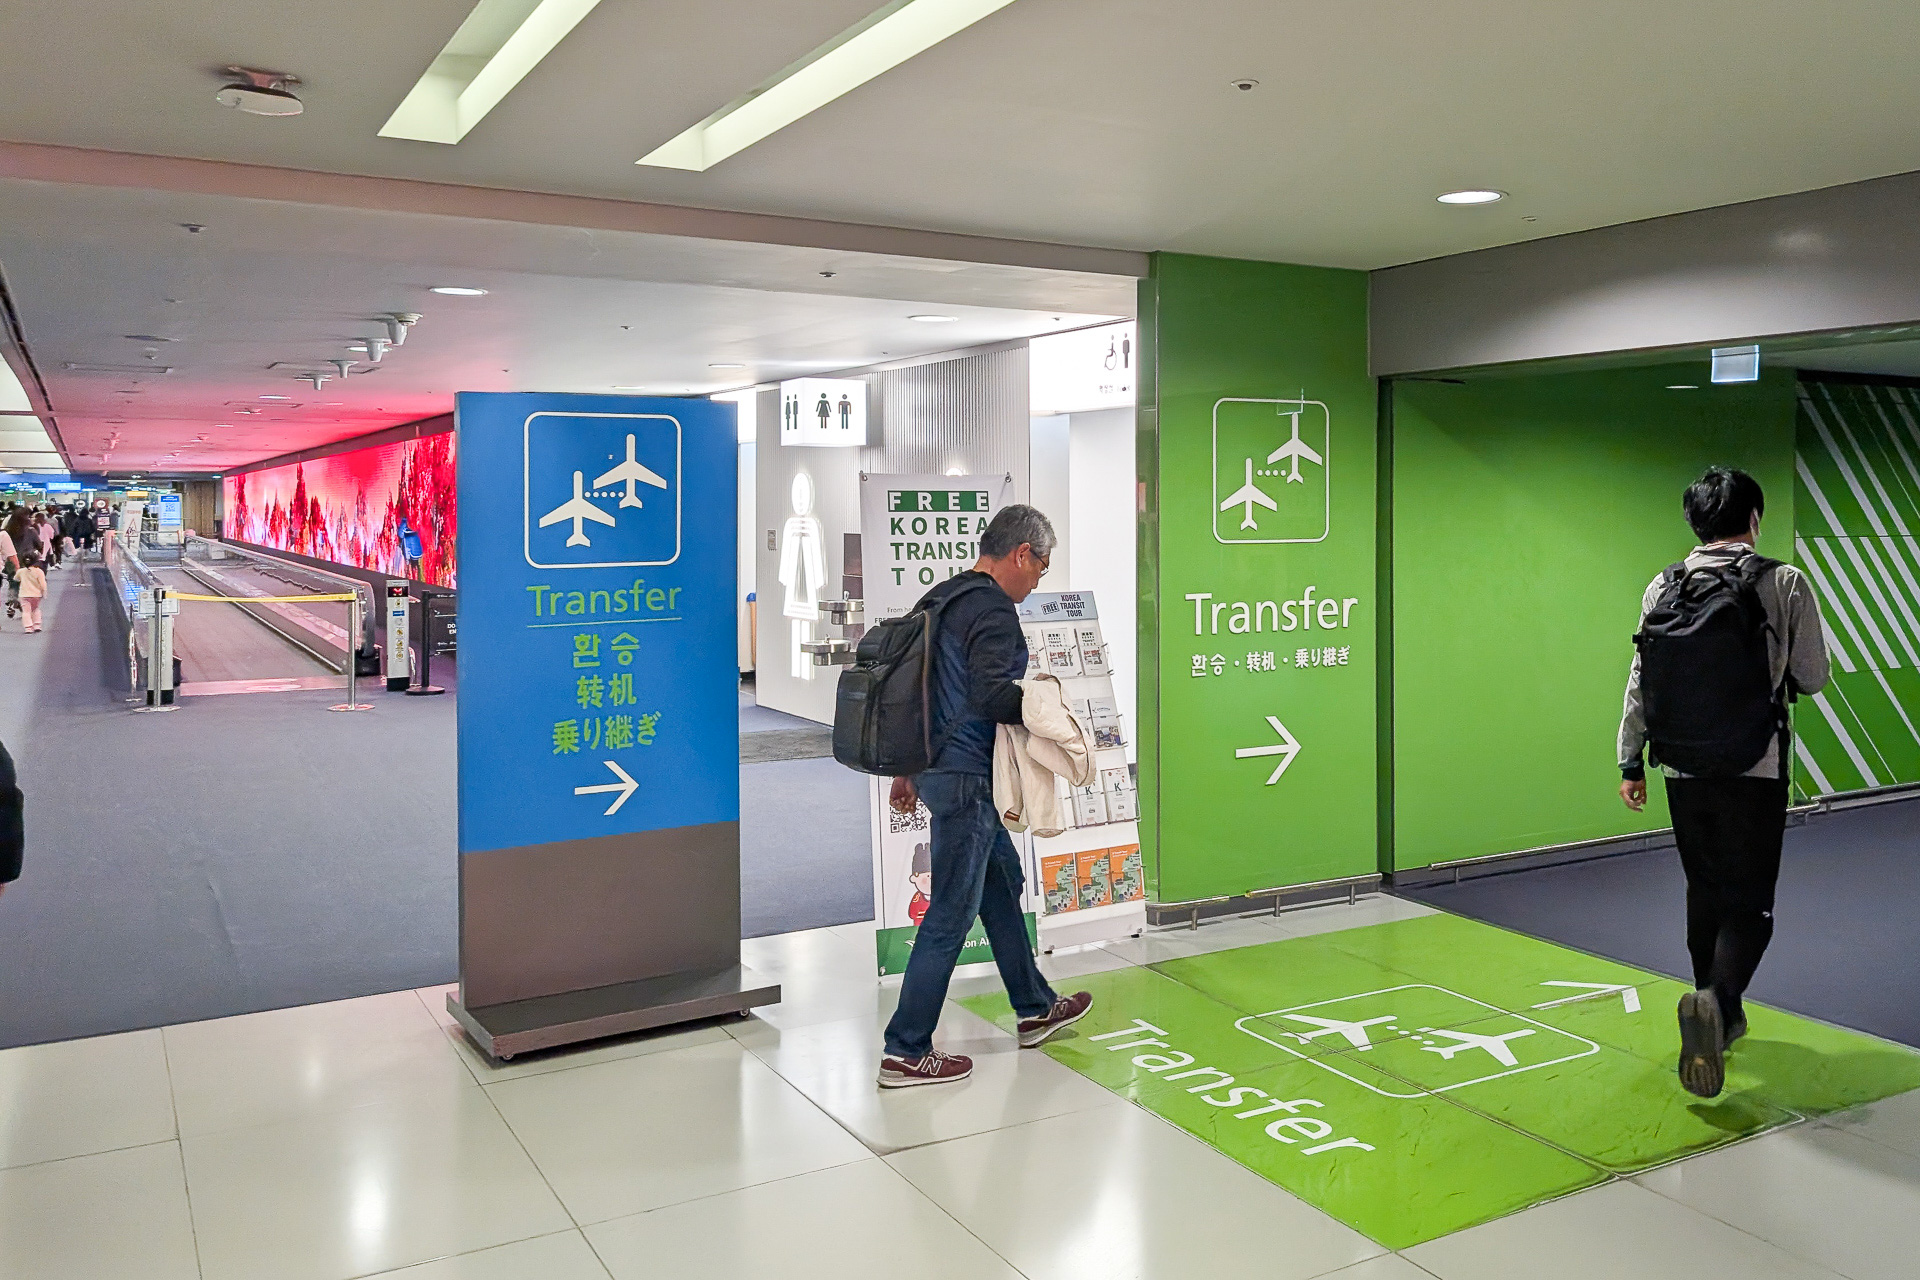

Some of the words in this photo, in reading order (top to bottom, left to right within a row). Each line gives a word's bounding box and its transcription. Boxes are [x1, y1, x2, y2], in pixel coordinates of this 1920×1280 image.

[889, 492, 989, 511] FREE
[890, 517, 988, 535] KOREA
[890, 541, 980, 560] TRANSI
[527, 579, 682, 616] Transfer
[1043, 602, 1058, 613] FREE
[1185, 586, 1358, 635] Transfer
[573, 632, 640, 668] 환승
[1191, 654, 1226, 678] 환승
[1246, 651, 1276, 673] 转机
[1295, 645, 1351, 669] 乗り継ぎ
[577, 673, 637, 709] 转机
[553, 711, 661, 755] 乗り継ぎ
[1088, 1018, 1376, 1156] Transfer
